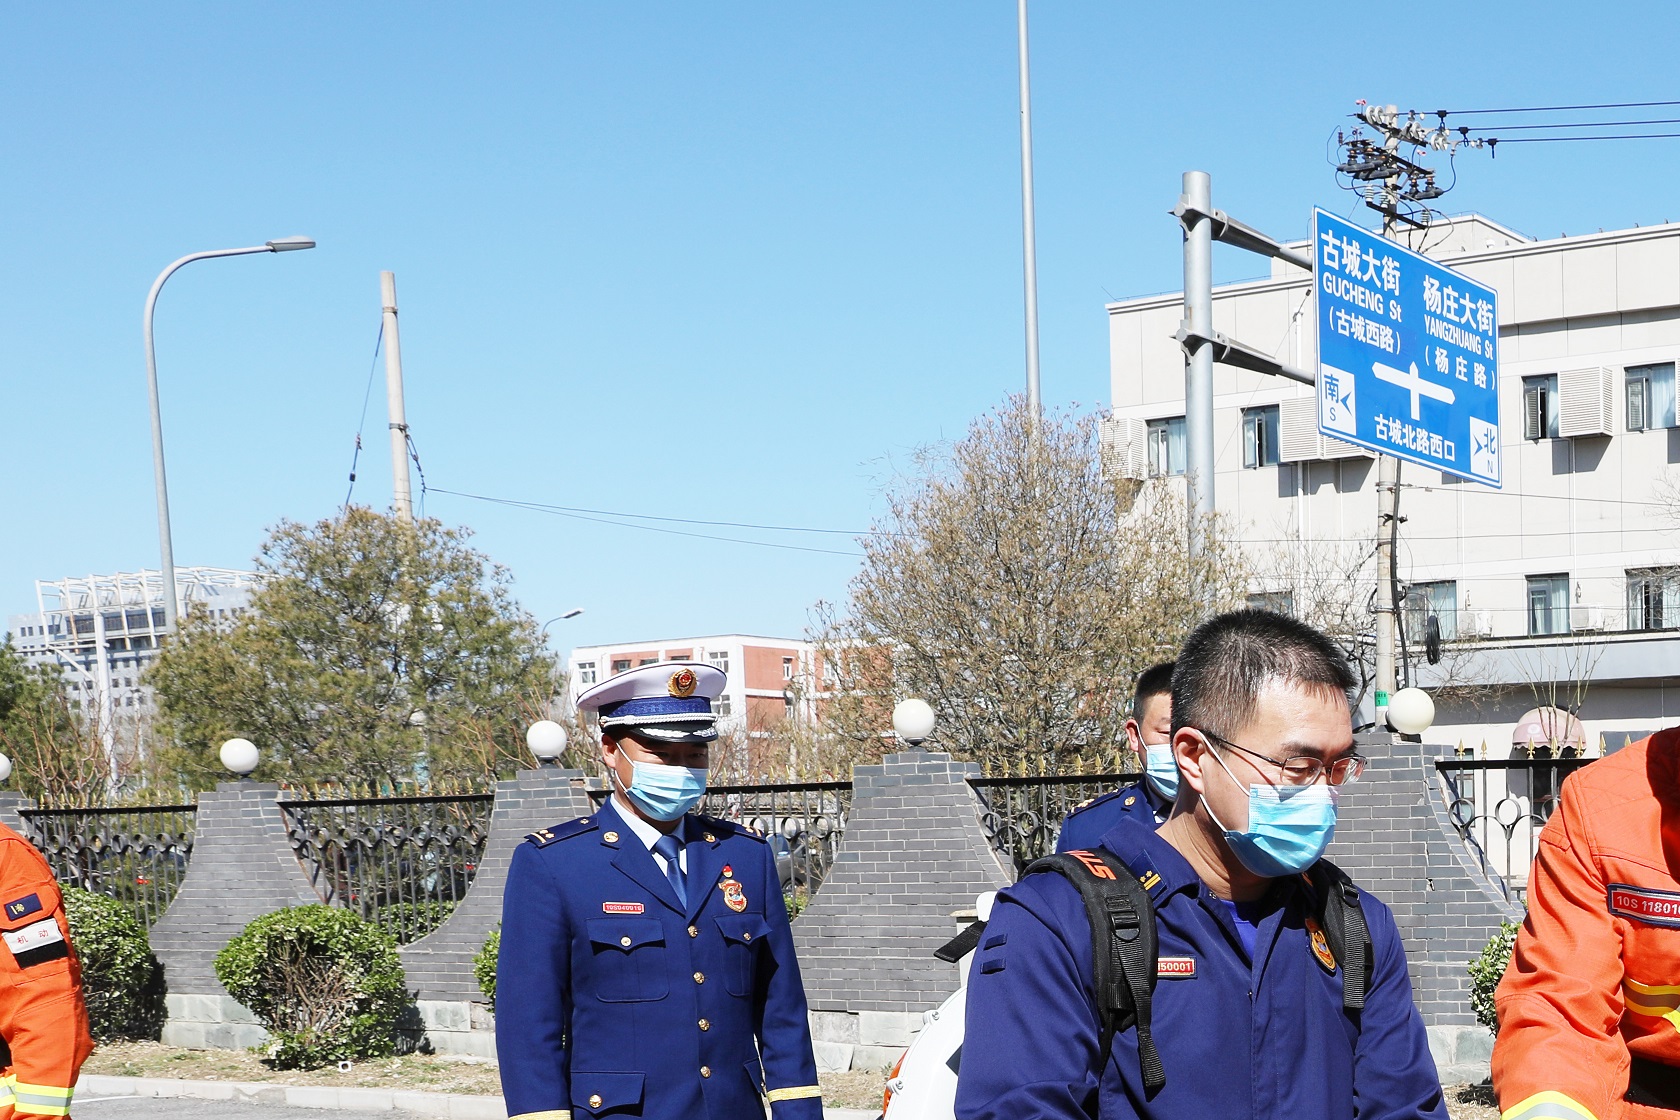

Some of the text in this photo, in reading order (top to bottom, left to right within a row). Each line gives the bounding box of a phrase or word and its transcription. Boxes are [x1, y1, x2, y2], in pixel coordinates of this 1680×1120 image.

[1321, 229, 1400, 296] 古城大街
[1323, 271, 1402, 323] GUCHENG St
[1423, 274, 1493, 337] 杨庄大街
[1424, 313, 1493, 360] YANGZHUANG St
[1324, 373, 1339, 404] 南
[1329, 407, 1337, 422] S
[1374, 414, 1456, 462] 古城北路西口
[1484, 426, 1496, 455] 北
[1487, 459, 1494, 474] N
[1616, 895, 1638, 909] 10S
